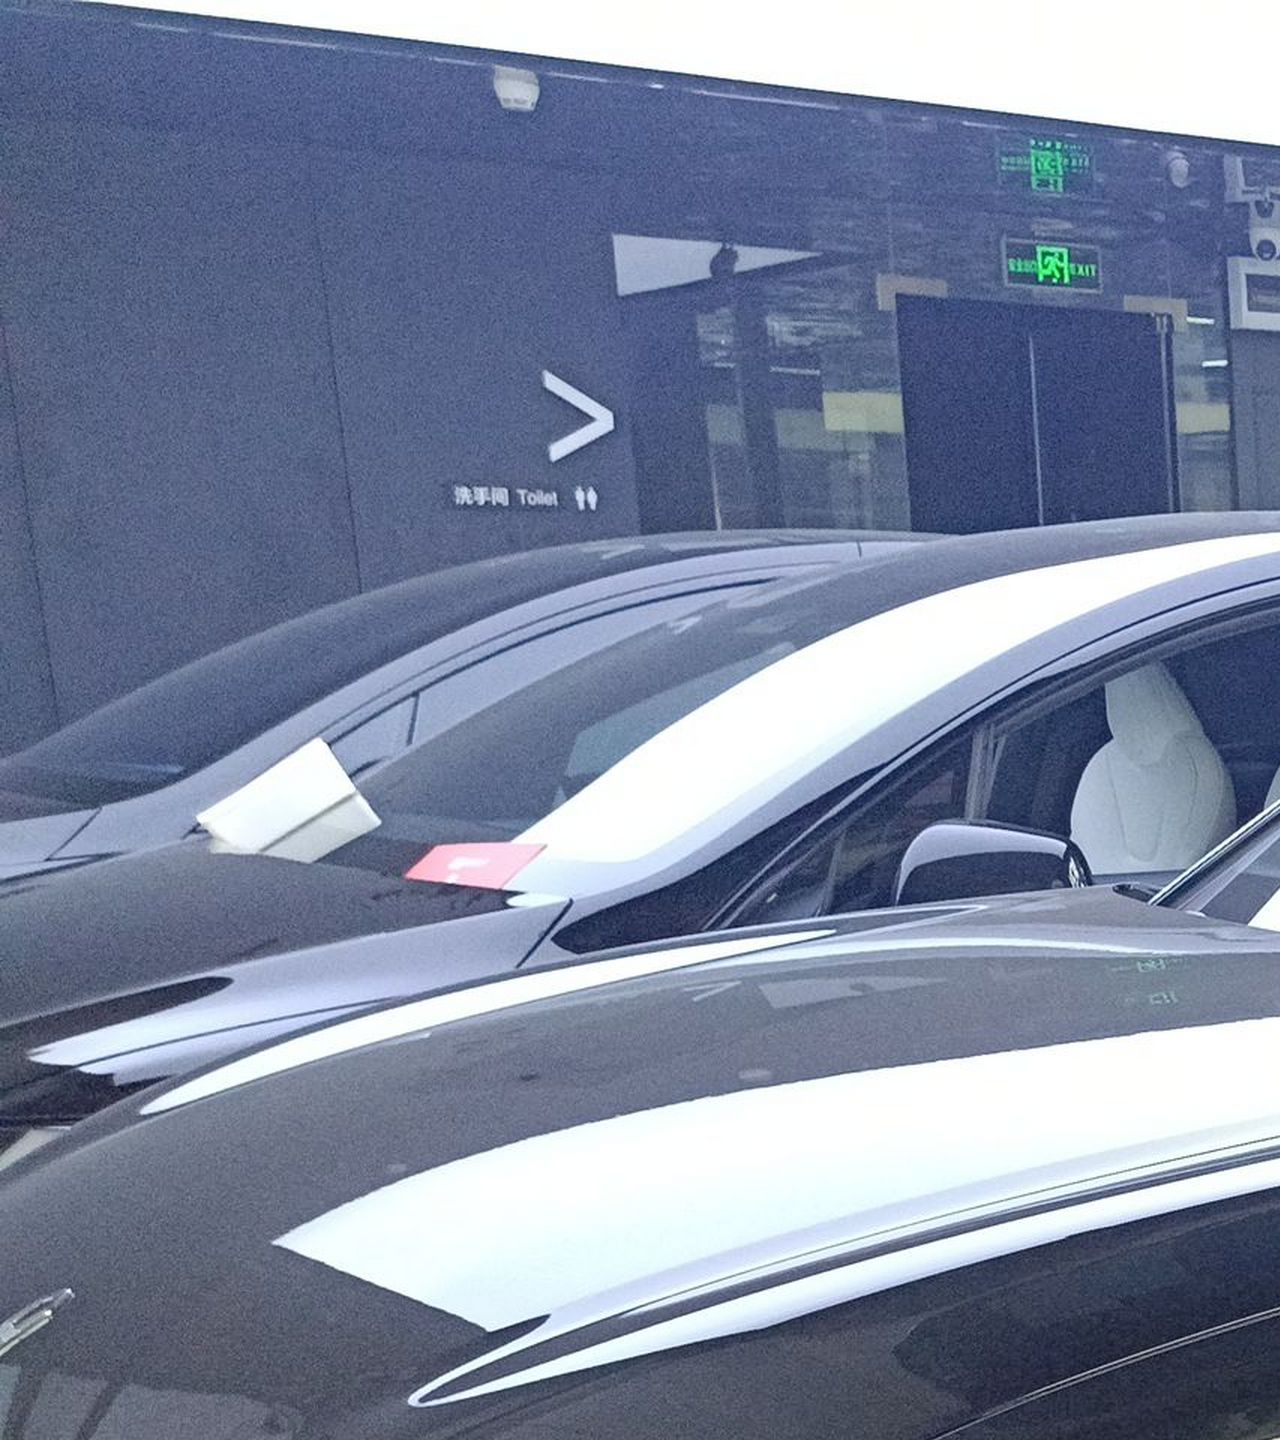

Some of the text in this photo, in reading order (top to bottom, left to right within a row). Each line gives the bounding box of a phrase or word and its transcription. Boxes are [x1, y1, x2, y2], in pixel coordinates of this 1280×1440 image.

[1069, 262, 1097, 277] EXIT
[454, 485, 558, 507] 洗手间 Toilet
